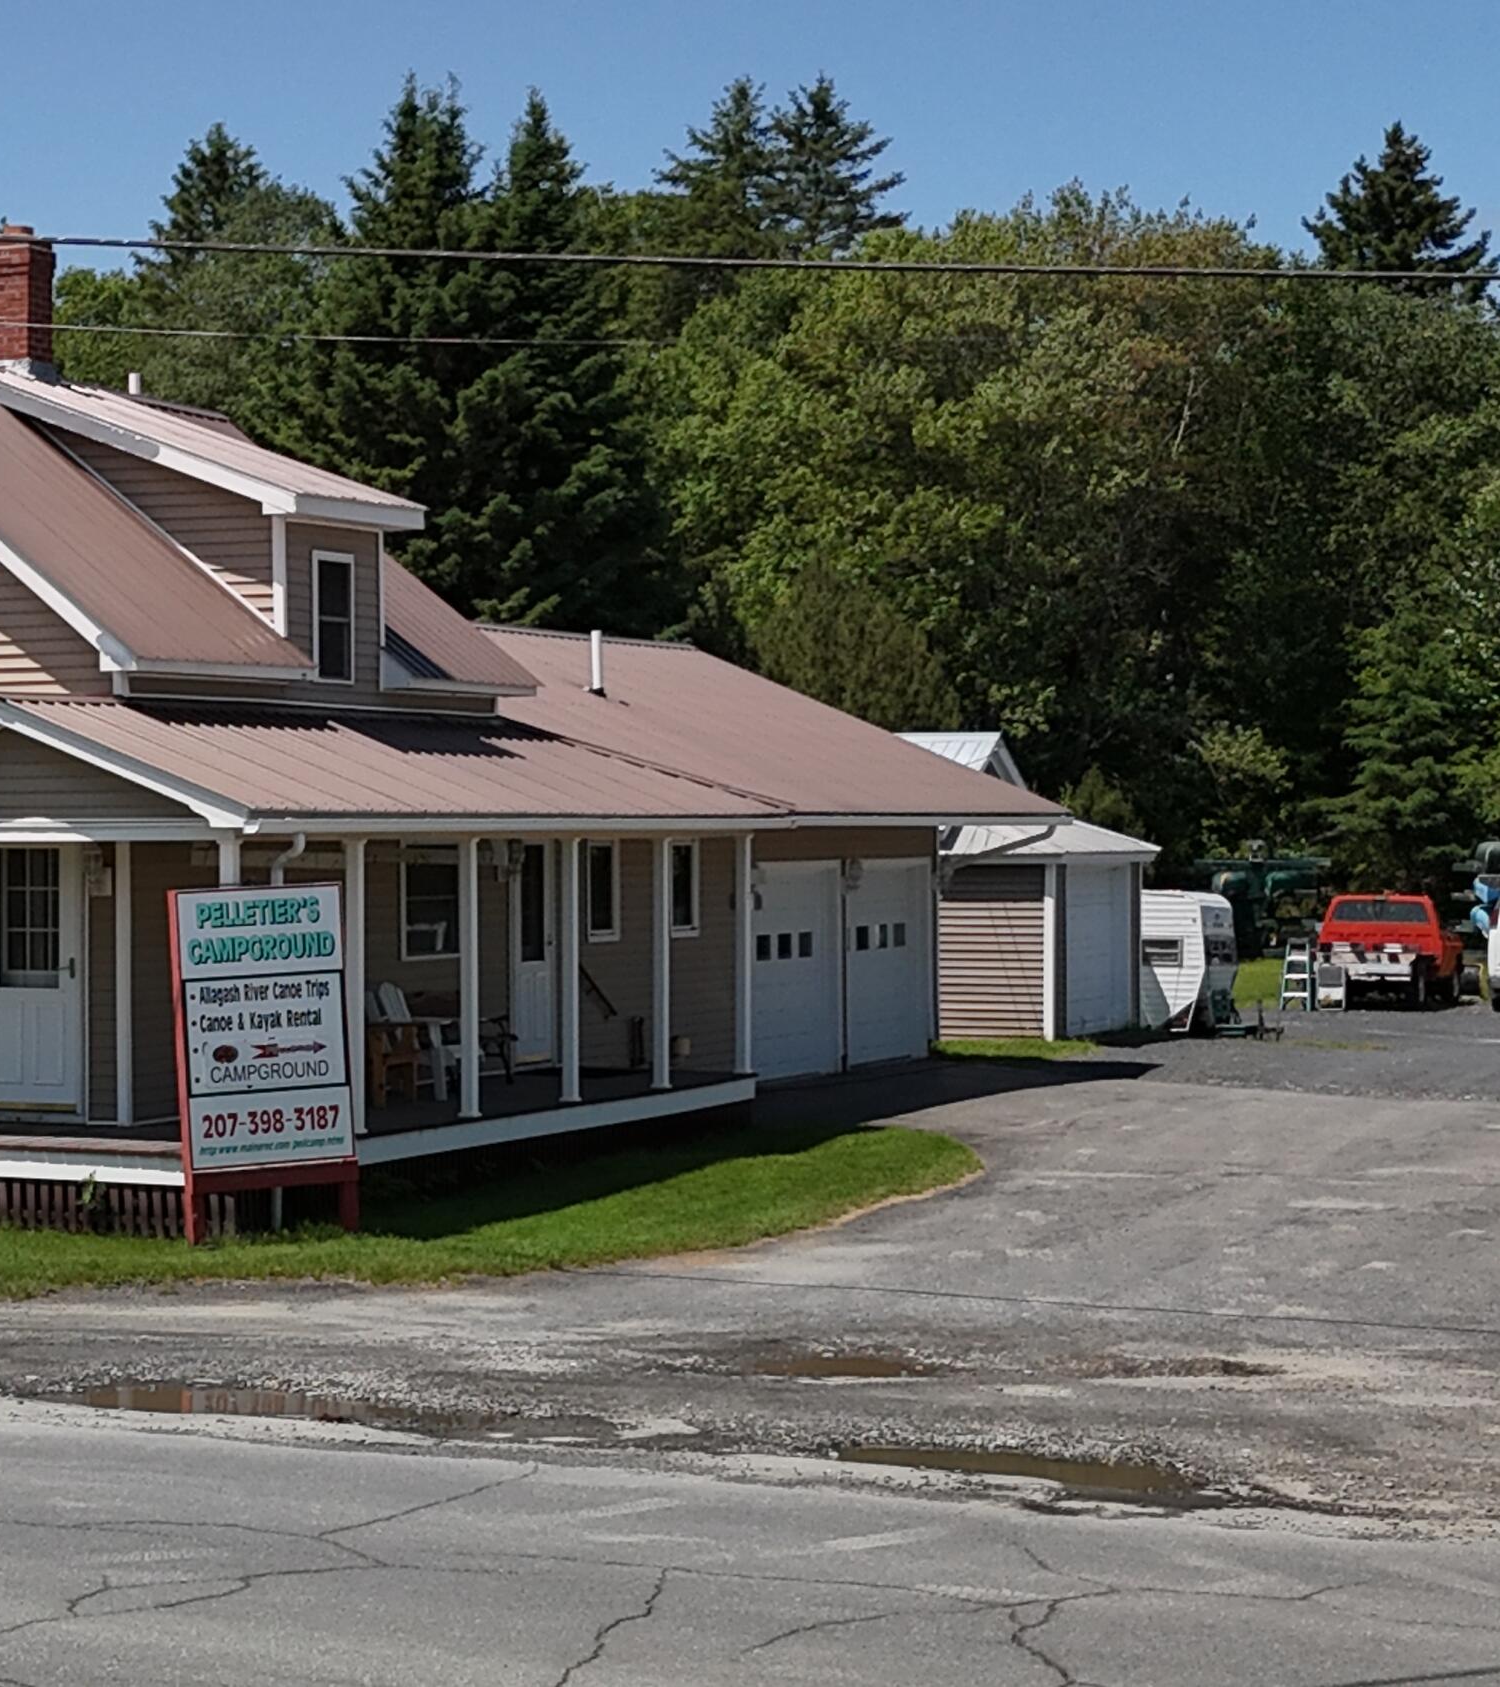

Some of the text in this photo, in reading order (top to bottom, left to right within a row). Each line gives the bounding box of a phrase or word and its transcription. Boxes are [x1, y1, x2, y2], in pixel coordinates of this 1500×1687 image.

[196, 896, 320, 929] PELLETIER'S
[187, 931, 335, 965] CAMPGROUND
[243, 983, 269, 1001] River
[272, 981, 302, 1000] Canoe
[305, 979, 330, 1000] Trips
[199, 1008, 322, 1033] Canoe & Kayak Rental
[210, 1059, 329, 1084] CAMPGROUND
[202, 1104, 339, 1139] 207-398-3187
